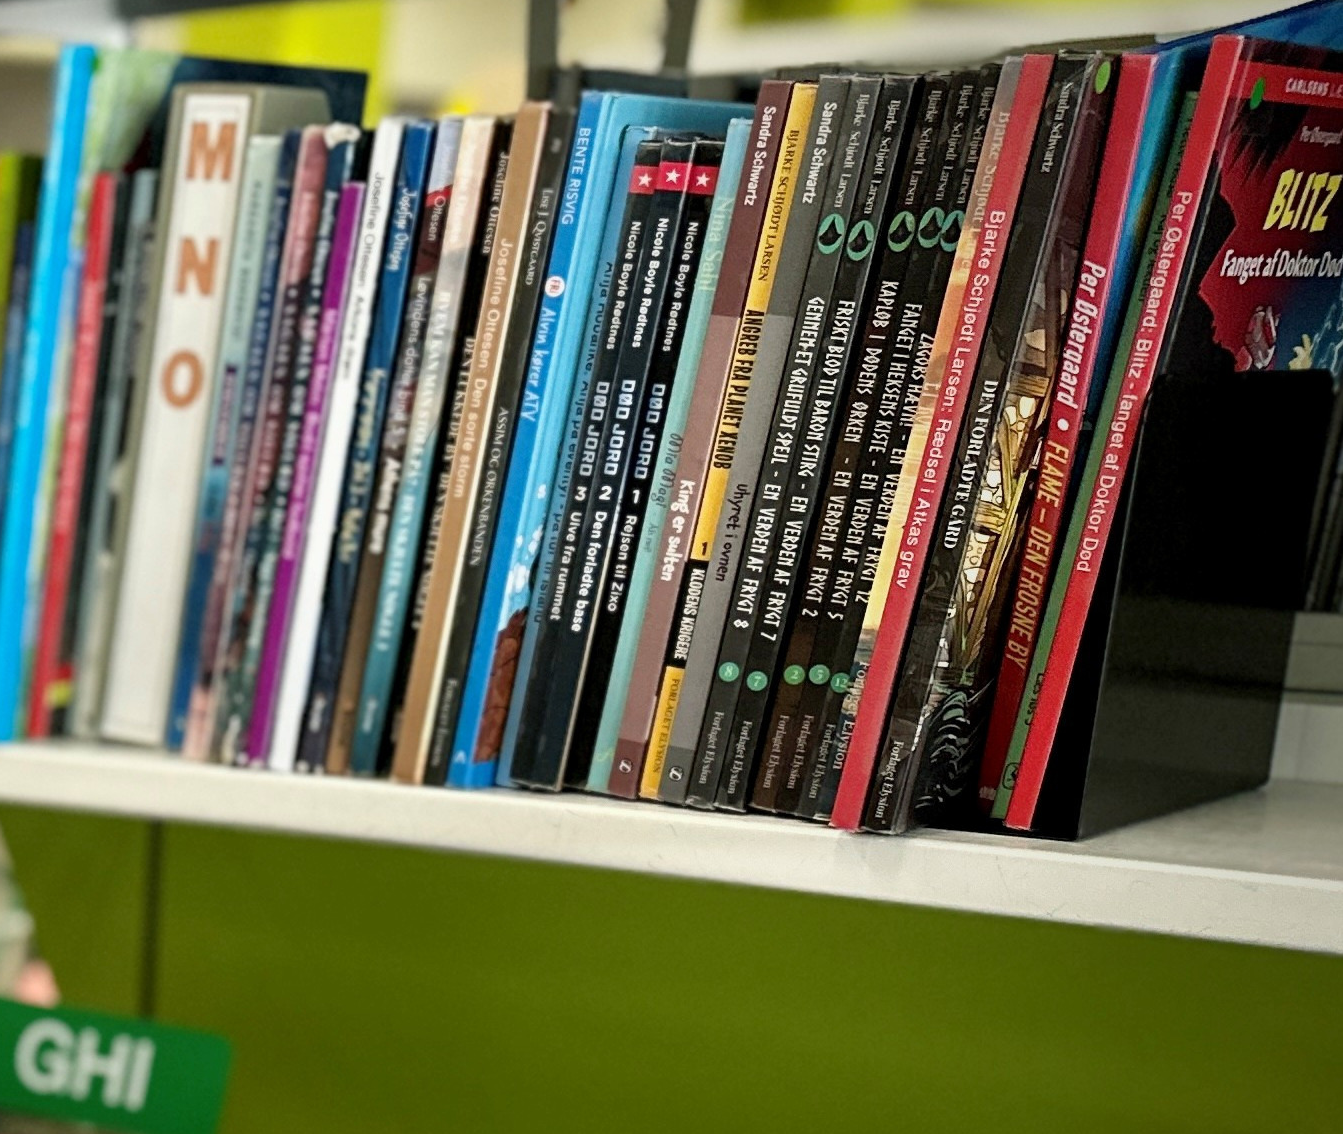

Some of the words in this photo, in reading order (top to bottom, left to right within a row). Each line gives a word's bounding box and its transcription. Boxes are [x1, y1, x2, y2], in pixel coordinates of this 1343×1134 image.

[757, 106, 776, 148] Sandra
[186, 121, 237, 181] M
[572, 128, 591, 174] BENTE
[744, 151, 767, 206] Schwartz
[562, 179, 581, 224] RISVIG
[1171, 192, 1193, 222] Per
[1263, 168, 1343, 232] BLITZ
[652, 218, 669, 257] Nicole
[978, 211, 1006, 269] Bjarke
[175, 236, 221, 296] N
[490, 238, 513, 305] Josefine
[644, 260, 660, 295] Boyle
[1079, 260, 1106, 297] Per
[1141, 227, 1182, 332] Østergaard:
[1220, 249, 1264, 285] Fanget
[1263, 248, 1280, 278] af
[1275, 249, 1321, 278] Doktor
[632, 298, 652, 347] Rødtnes
[799, 297, 825, 348] GENNEM
[959, 274, 989, 342] Schjødt
[534, 307, 556, 355] Alvin
[738, 310, 765, 355] ANGREB
[732, 360, 754, 380] FRA
[794, 351, 813, 366] ET
[1057, 298, 1098, 409] Østergaard
[1128, 339, 1153, 378] Blitz
[471, 378, 487, 408] Den
[616, 380, 636, 419] DØD
[780, 368, 808, 430] GRUFULDT
[941, 347, 971, 412] Larsen:
[978, 380, 998, 414] DEN
[521, 390, 539, 421] ATV
[647, 384, 666, 423] DØD
[722, 385, 749, 429] PLANET
[1109, 394, 1138, 448] fanget
[462, 412, 478, 451] sorte
[493, 407, 509, 445] ASSIM
[489, 448, 501, 465] OG
[604, 424, 625, 475] JORD
[635, 428, 655, 479] JORD
[714, 431, 738, 469] XENOB
[771, 432, 793, 464] SPEJL
[923, 419, 952, 483] Rædsel
[955, 417, 989, 501] FORLADTE
[1104, 453, 1119, 470] af
[454, 455, 470, 498] storm
[599, 485, 612, 500] 2
[763, 484, 781, 500] EN
[1037, 440, 1069, 507] FLAME
[470, 470, 497, 565] ØRKENBANDEN
[670, 480, 696, 514] King
[1088, 475, 1116, 533] Doktor
[591, 511, 607, 538] Den
[618, 515, 637, 560] Rejsen
[672, 516, 685, 533] er
[750, 508, 776, 553] VERDEN
[907, 498, 930, 545] Atkas
[944, 505, 966, 548] GÅRD
[661, 536, 682, 581] sulten
[715, 542, 732, 582] ovnen
[746, 556, 764, 573] AF
[1025, 526, 1052, 567] DEN
[1077, 537, 1099, 572] Død
[579, 542, 601, 596] forladte
[614, 564, 627, 578] til
[896, 551, 914, 588] grav
[571, 600, 589, 632] base
[608, 582, 623, 612] Zixo
[737, 578, 759, 614] FRYGT
[1011, 566, 1044, 639] FROSNE
[1006, 640, 1029, 670] BY
[14, 1016, 157, 1112] GHI
